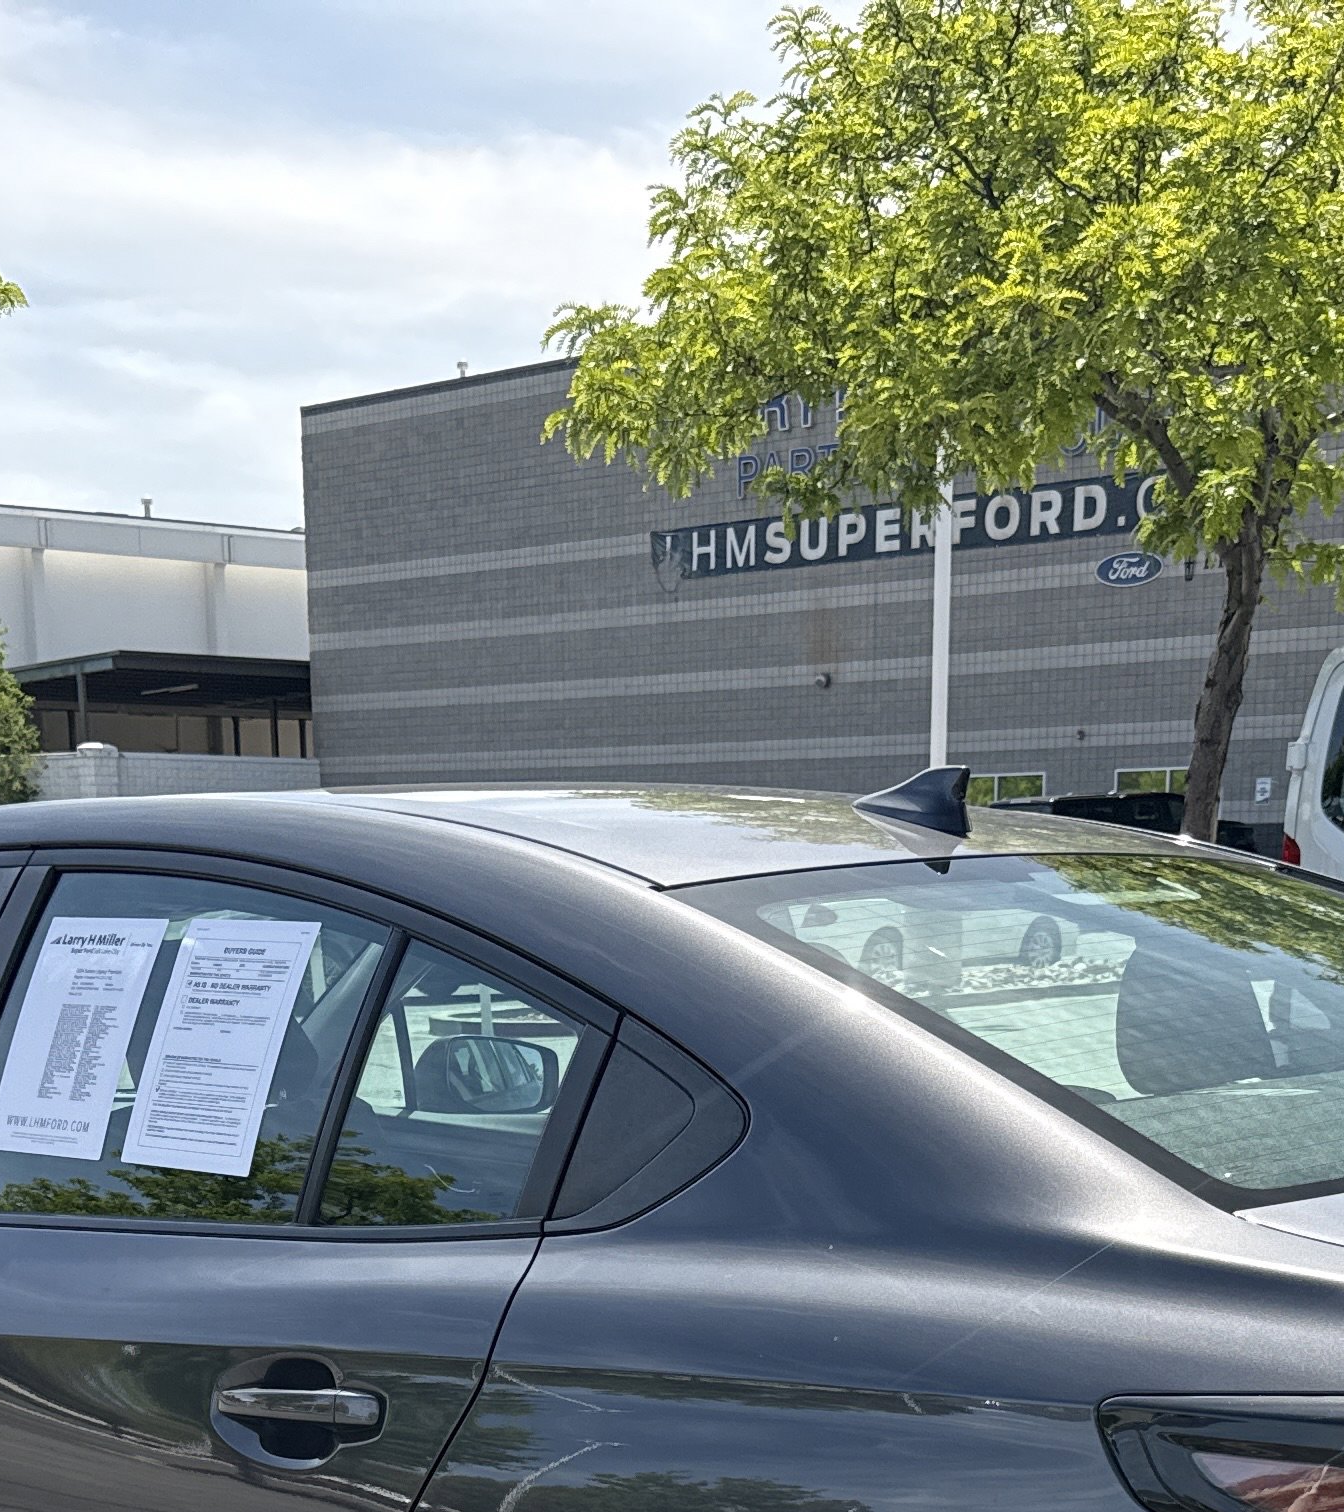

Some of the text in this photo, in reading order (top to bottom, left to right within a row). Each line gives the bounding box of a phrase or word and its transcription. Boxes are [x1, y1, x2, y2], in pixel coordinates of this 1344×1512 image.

[1108, 556, 1149, 581] Ford
[62, 934, 88, 948] Larry
[88, 935, 97, 945] H
[96, 934, 126, 946] Miller
[7, 1115, 91, 1132] WWW.LHMFORD.COM
